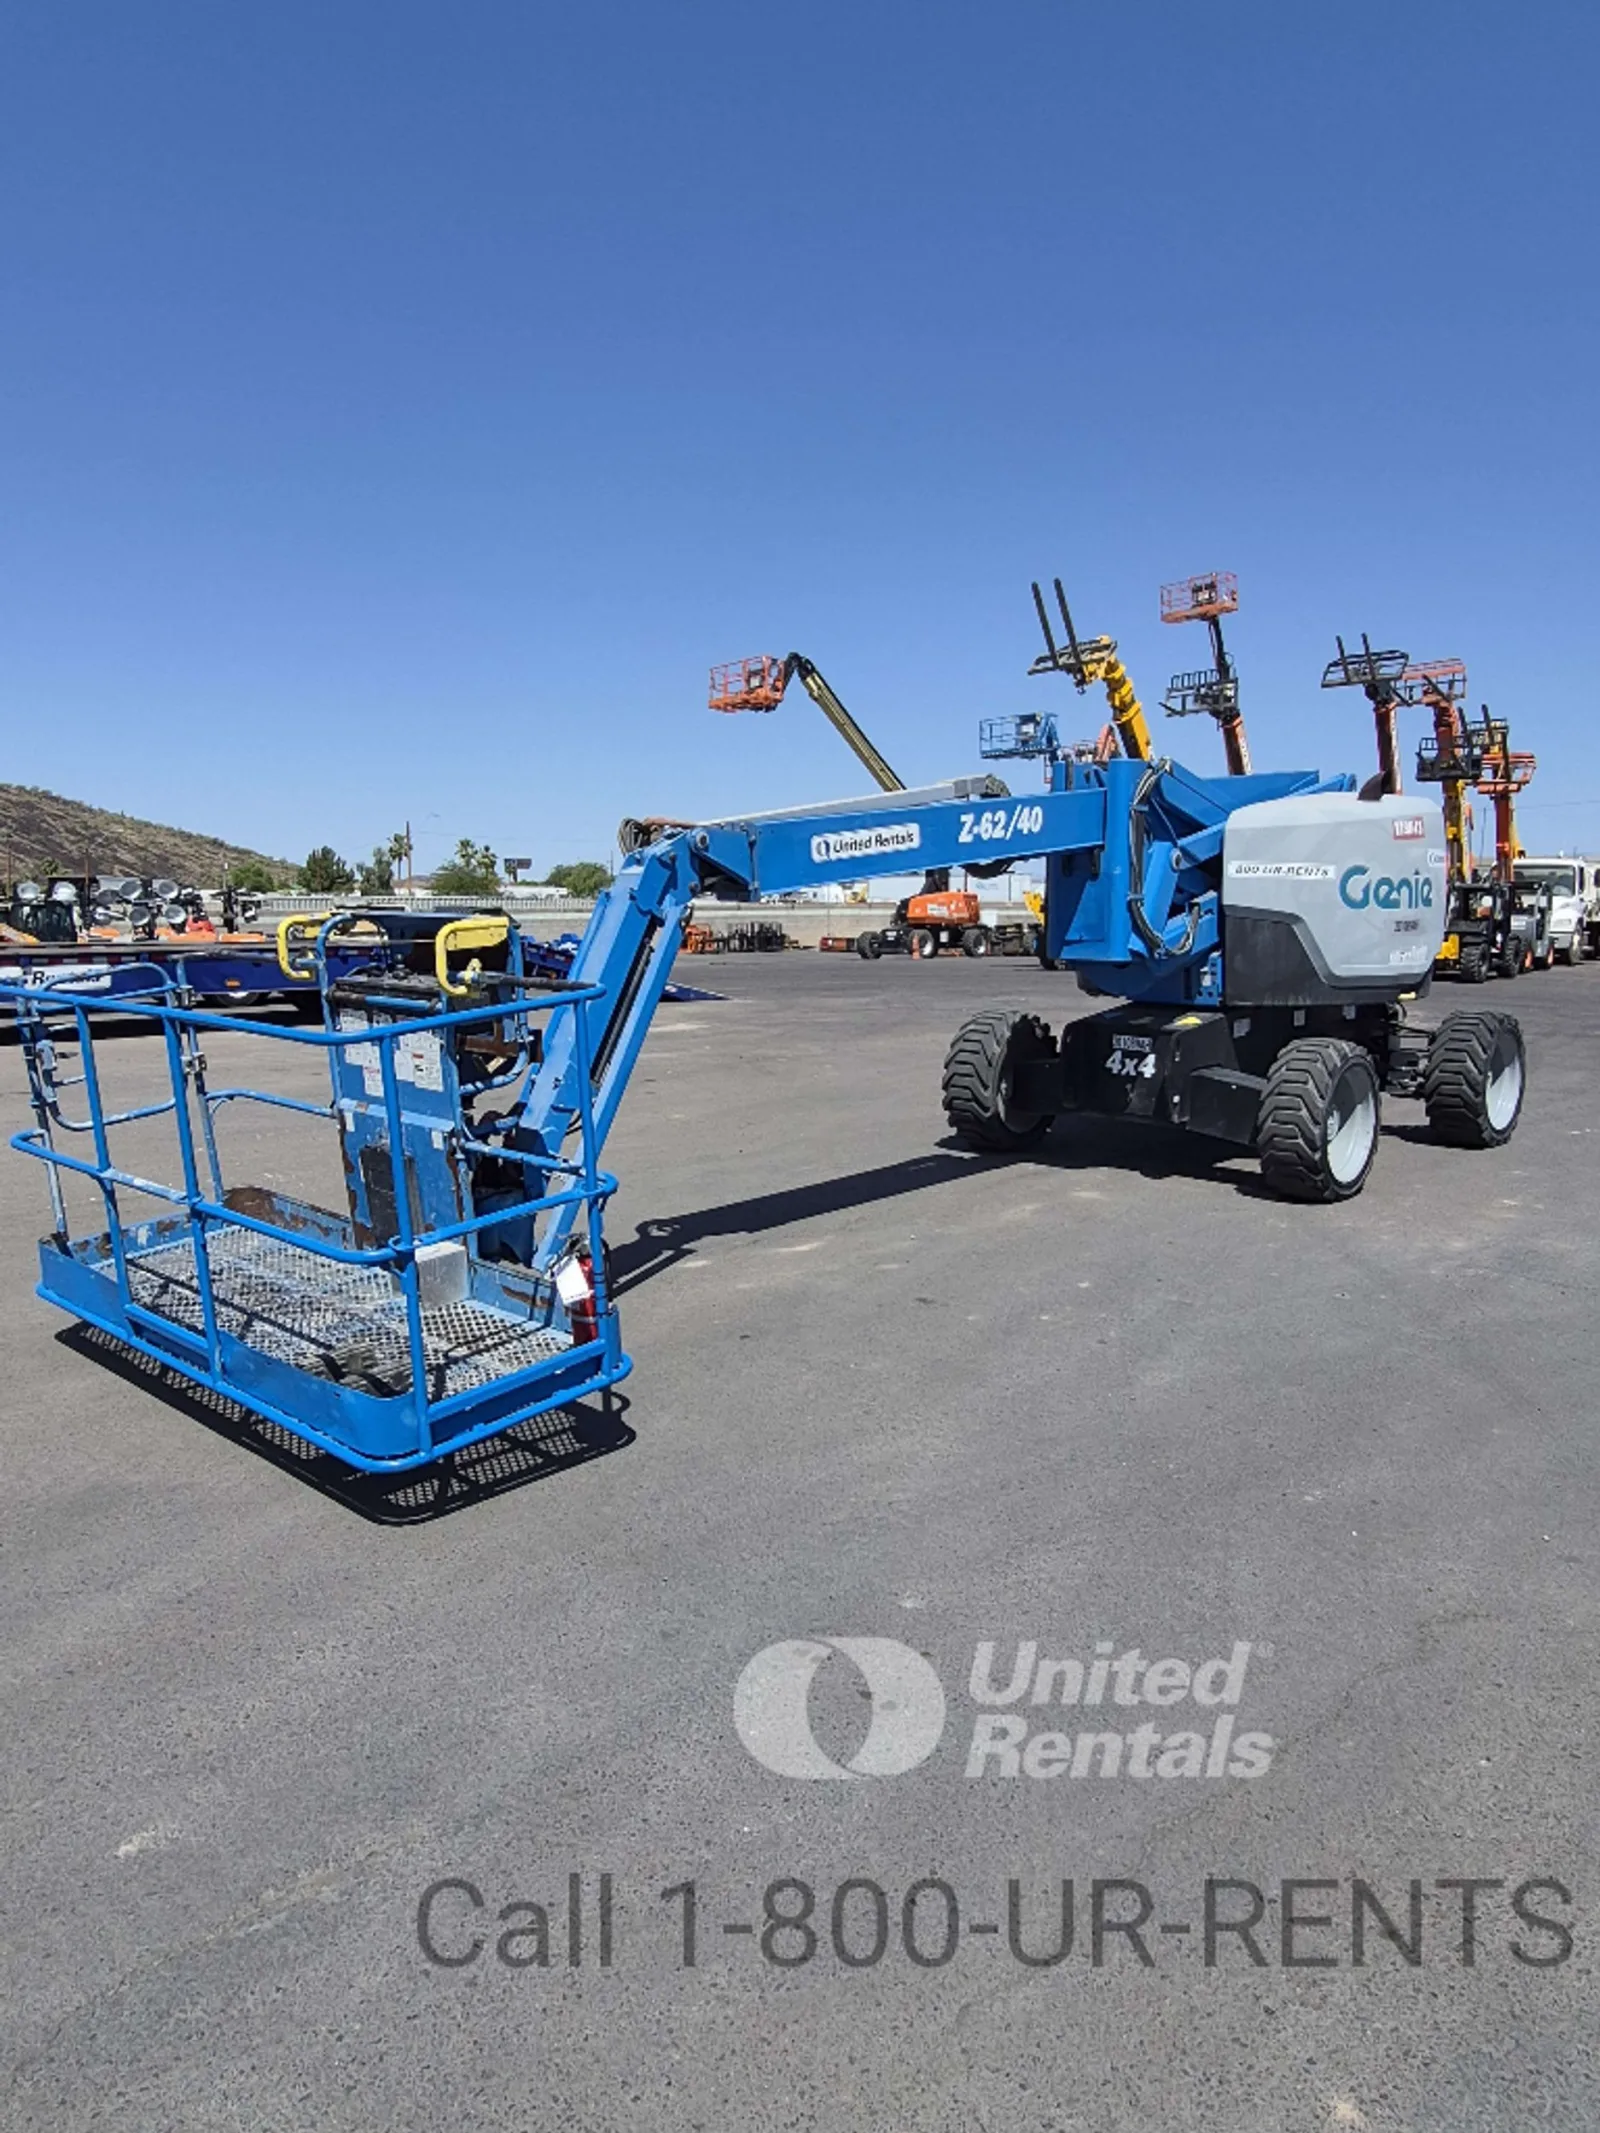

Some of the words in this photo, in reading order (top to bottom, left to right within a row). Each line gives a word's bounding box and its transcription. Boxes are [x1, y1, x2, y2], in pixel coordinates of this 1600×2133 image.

[833, 836, 872, 853] United
[875, 830, 914, 847] Rentals
[958, 804, 1043, 843] Z-62/40
[1339, 865, 1433, 910] Genie
